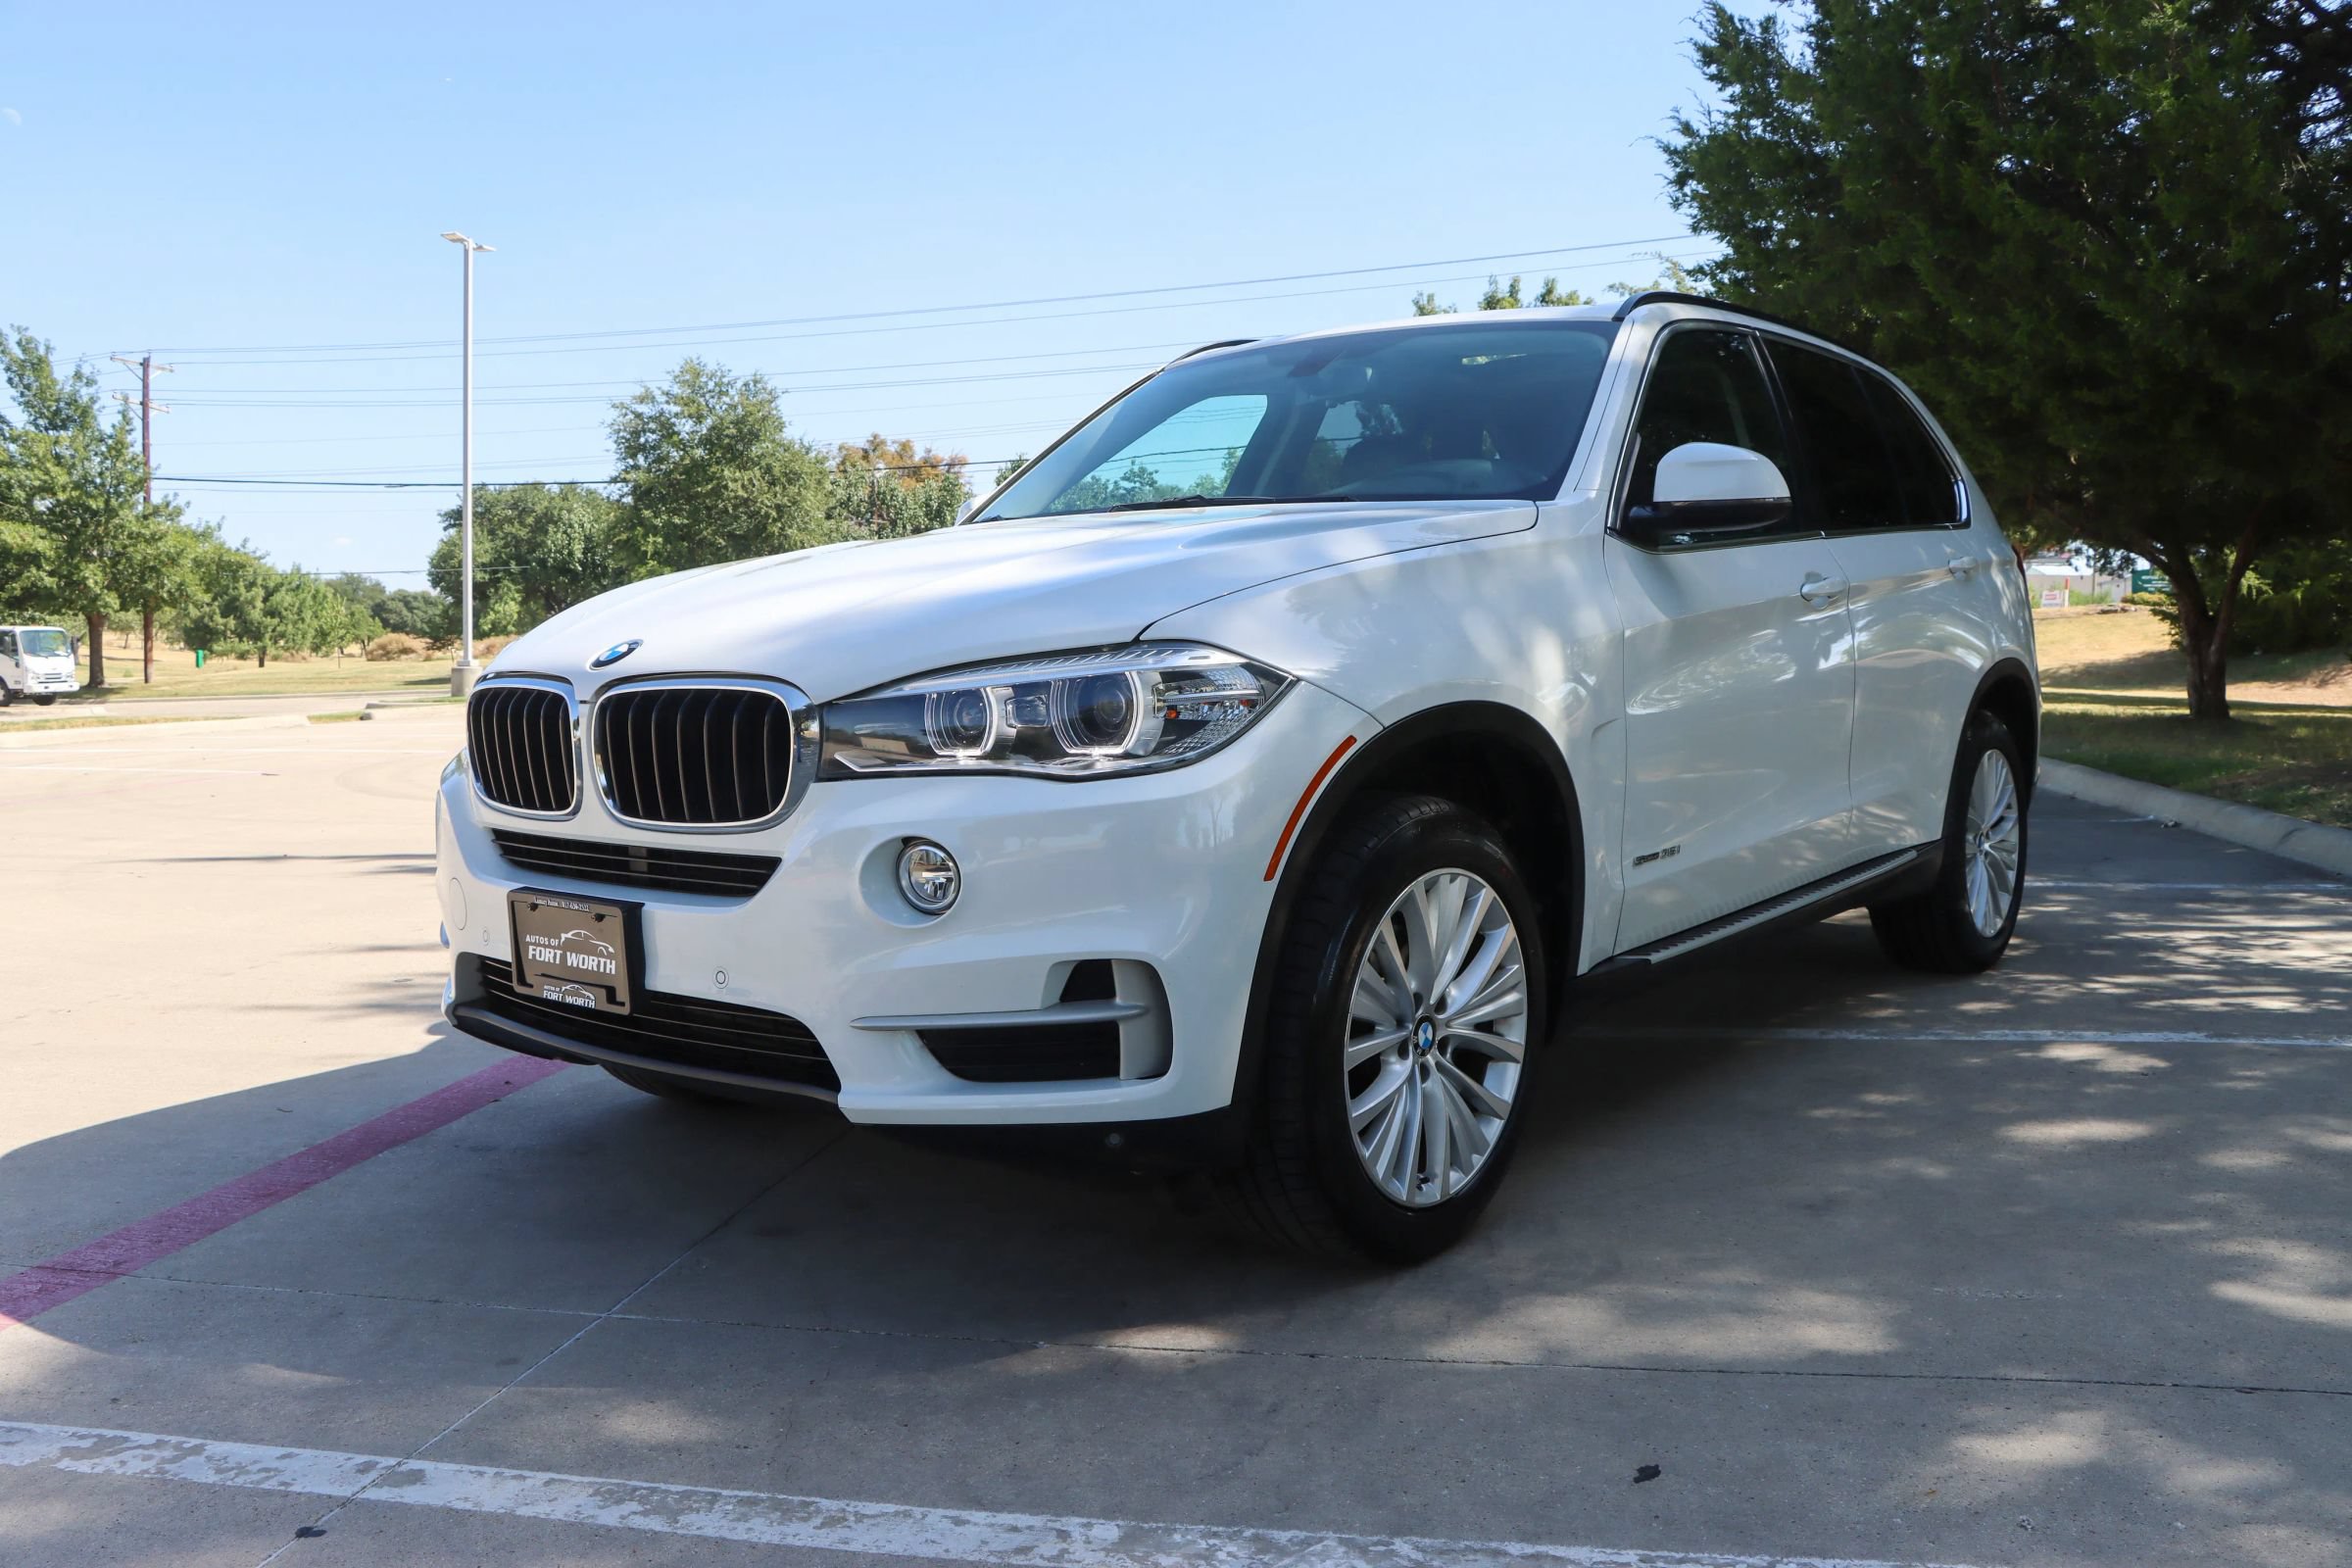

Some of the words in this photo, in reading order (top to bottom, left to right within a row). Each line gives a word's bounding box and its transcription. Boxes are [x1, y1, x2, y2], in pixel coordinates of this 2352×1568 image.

[526, 935, 549, 945] AUTOS
[528, 947, 562, 964] FORT
[566, 953, 615, 974] WORTH
[543, 991, 563, 1002] FORT
[565, 996, 595, 1008] WORTH
